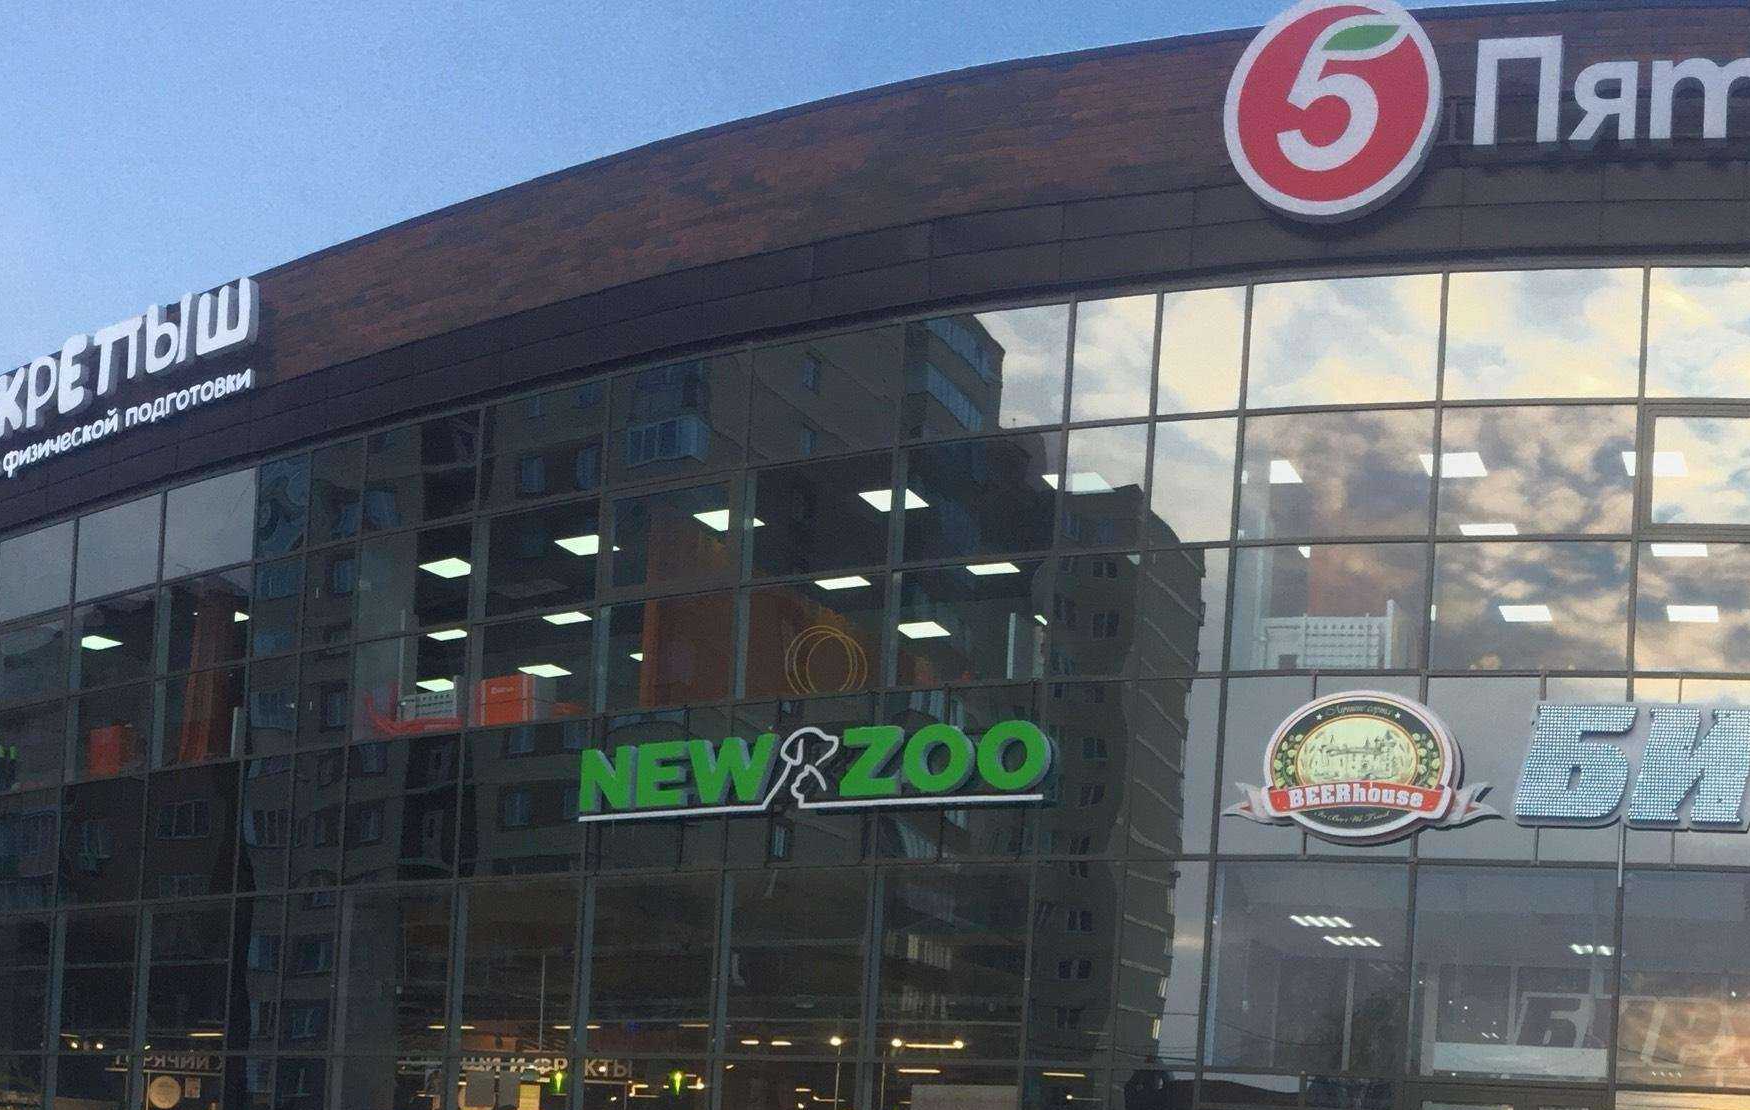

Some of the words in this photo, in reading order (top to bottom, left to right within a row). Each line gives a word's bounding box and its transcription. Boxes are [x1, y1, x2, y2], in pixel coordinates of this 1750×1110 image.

[1274, 51, 1389, 173] 5
[2, 409, 121, 479] физической
[124, 368, 253, 429] подготовки
[578, 731, 780, 815] NEW
[838, 719, 1053, 801] ZOO
[533, 1057, 633, 1077] ФРКТЫ
